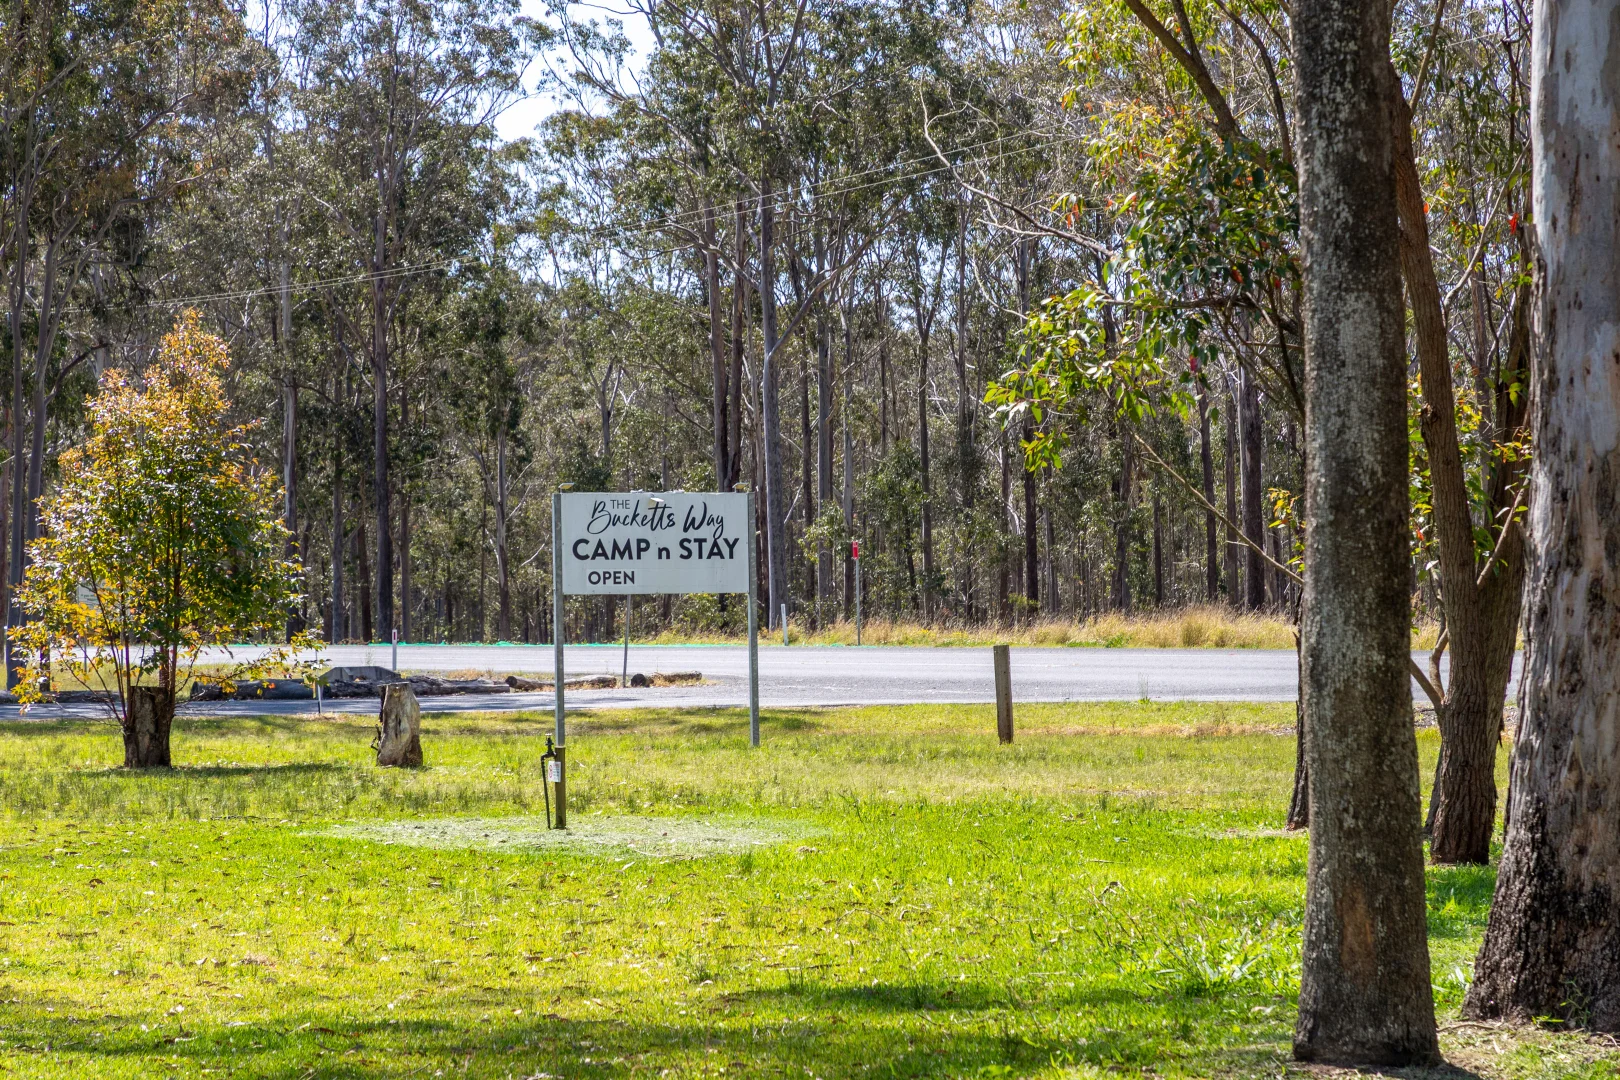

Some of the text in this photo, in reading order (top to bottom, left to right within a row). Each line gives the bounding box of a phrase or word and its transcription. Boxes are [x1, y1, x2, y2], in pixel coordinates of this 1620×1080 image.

[610, 499, 631, 509] THE
[587, 499, 724, 539] Bucketts Way
[572, 537, 740, 560] CAMP n STAY
[588, 570, 635, 585] OPEN
